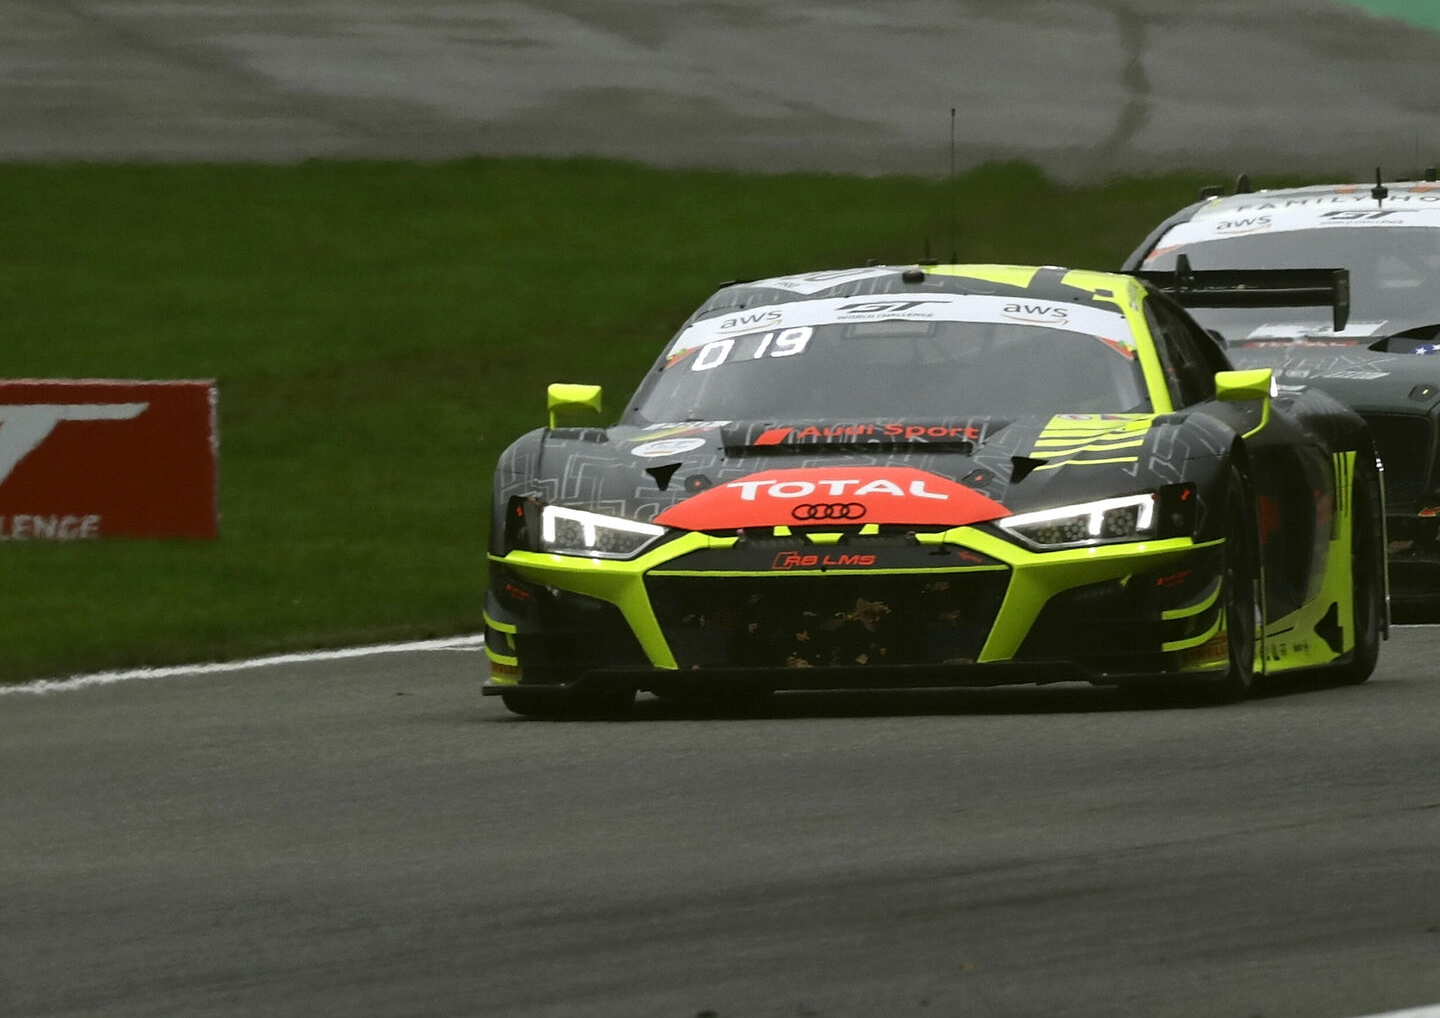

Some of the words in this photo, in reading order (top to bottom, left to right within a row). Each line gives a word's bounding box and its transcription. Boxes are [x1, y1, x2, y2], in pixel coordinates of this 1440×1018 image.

[1216, 214, 1272, 231] aws
[1003, 301, 1069, 319] aws
[719, 309, 784, 331] aws
[796, 422, 875, 439] Audi
[878, 421, 981, 441] Sport
[727, 478, 949, 501] TOTAL
[782, 553, 819, 567] R8
[822, 553, 877, 566] LMS
